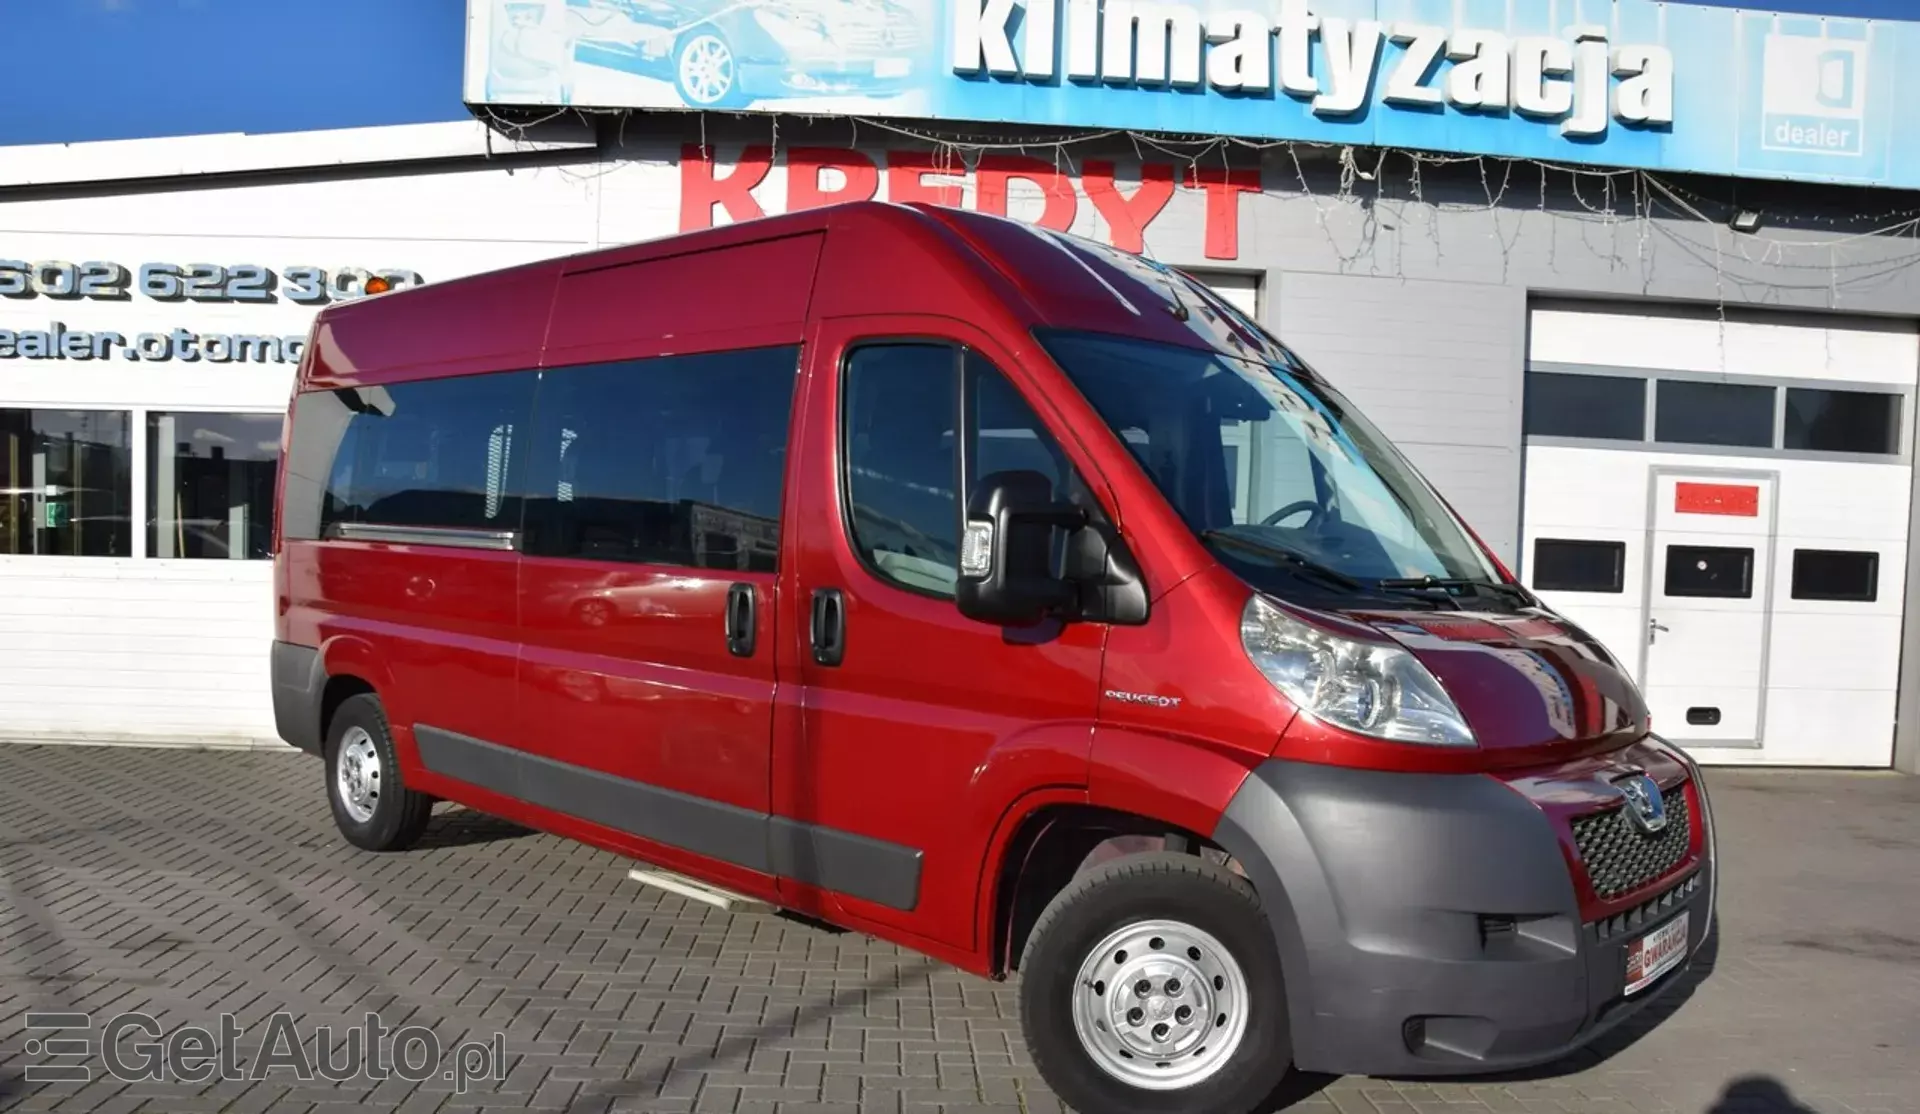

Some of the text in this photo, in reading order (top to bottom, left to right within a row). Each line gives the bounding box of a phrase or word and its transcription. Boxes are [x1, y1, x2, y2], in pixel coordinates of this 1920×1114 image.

[953, 0, 1674, 138] klimatyzacja
[1774, 119, 1852, 148] dealer
[139, 262, 277, 304] 622
[1105, 690, 1182, 708] PEUGEOT
